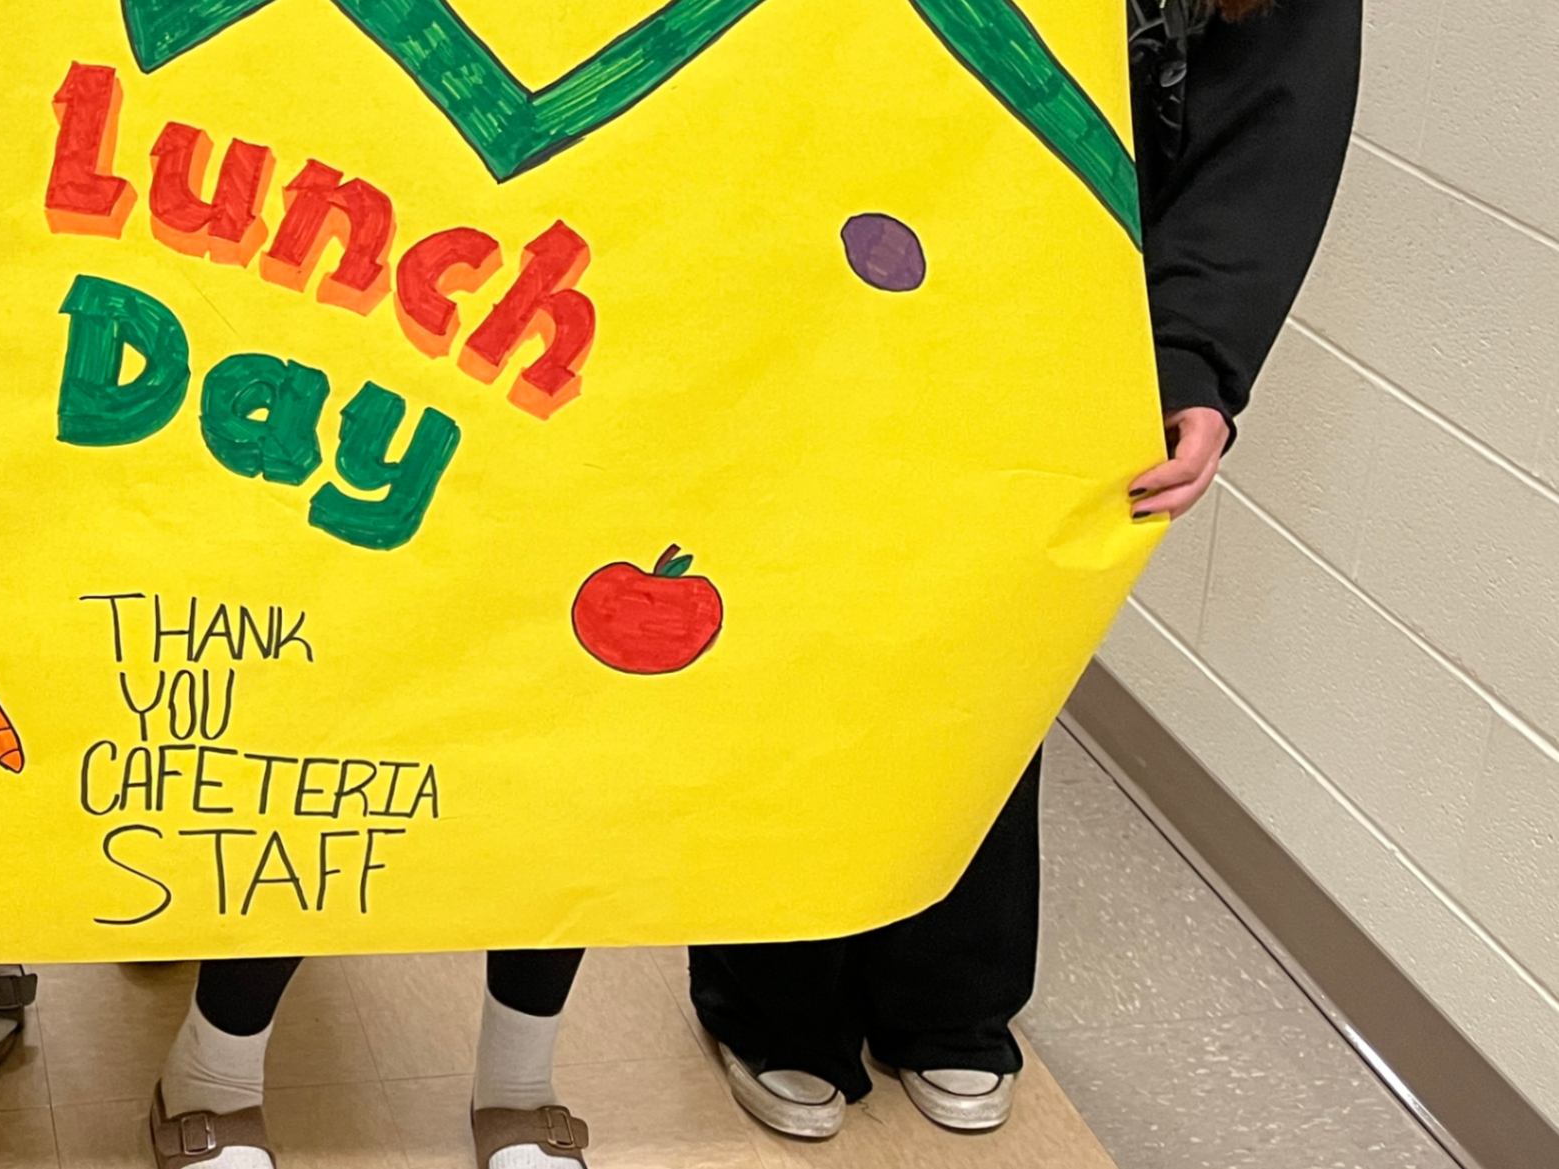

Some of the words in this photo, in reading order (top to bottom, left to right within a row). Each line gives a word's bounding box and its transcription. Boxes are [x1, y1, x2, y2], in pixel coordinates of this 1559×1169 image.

[45, 61, 597, 420] Lunch
[56, 274, 461, 551] Day
[79, 593, 314, 663] THANK
[119, 668, 235, 742] YOU
[79, 740, 439, 819] CAFETERIA
[93, 824, 407, 925] STAFF
